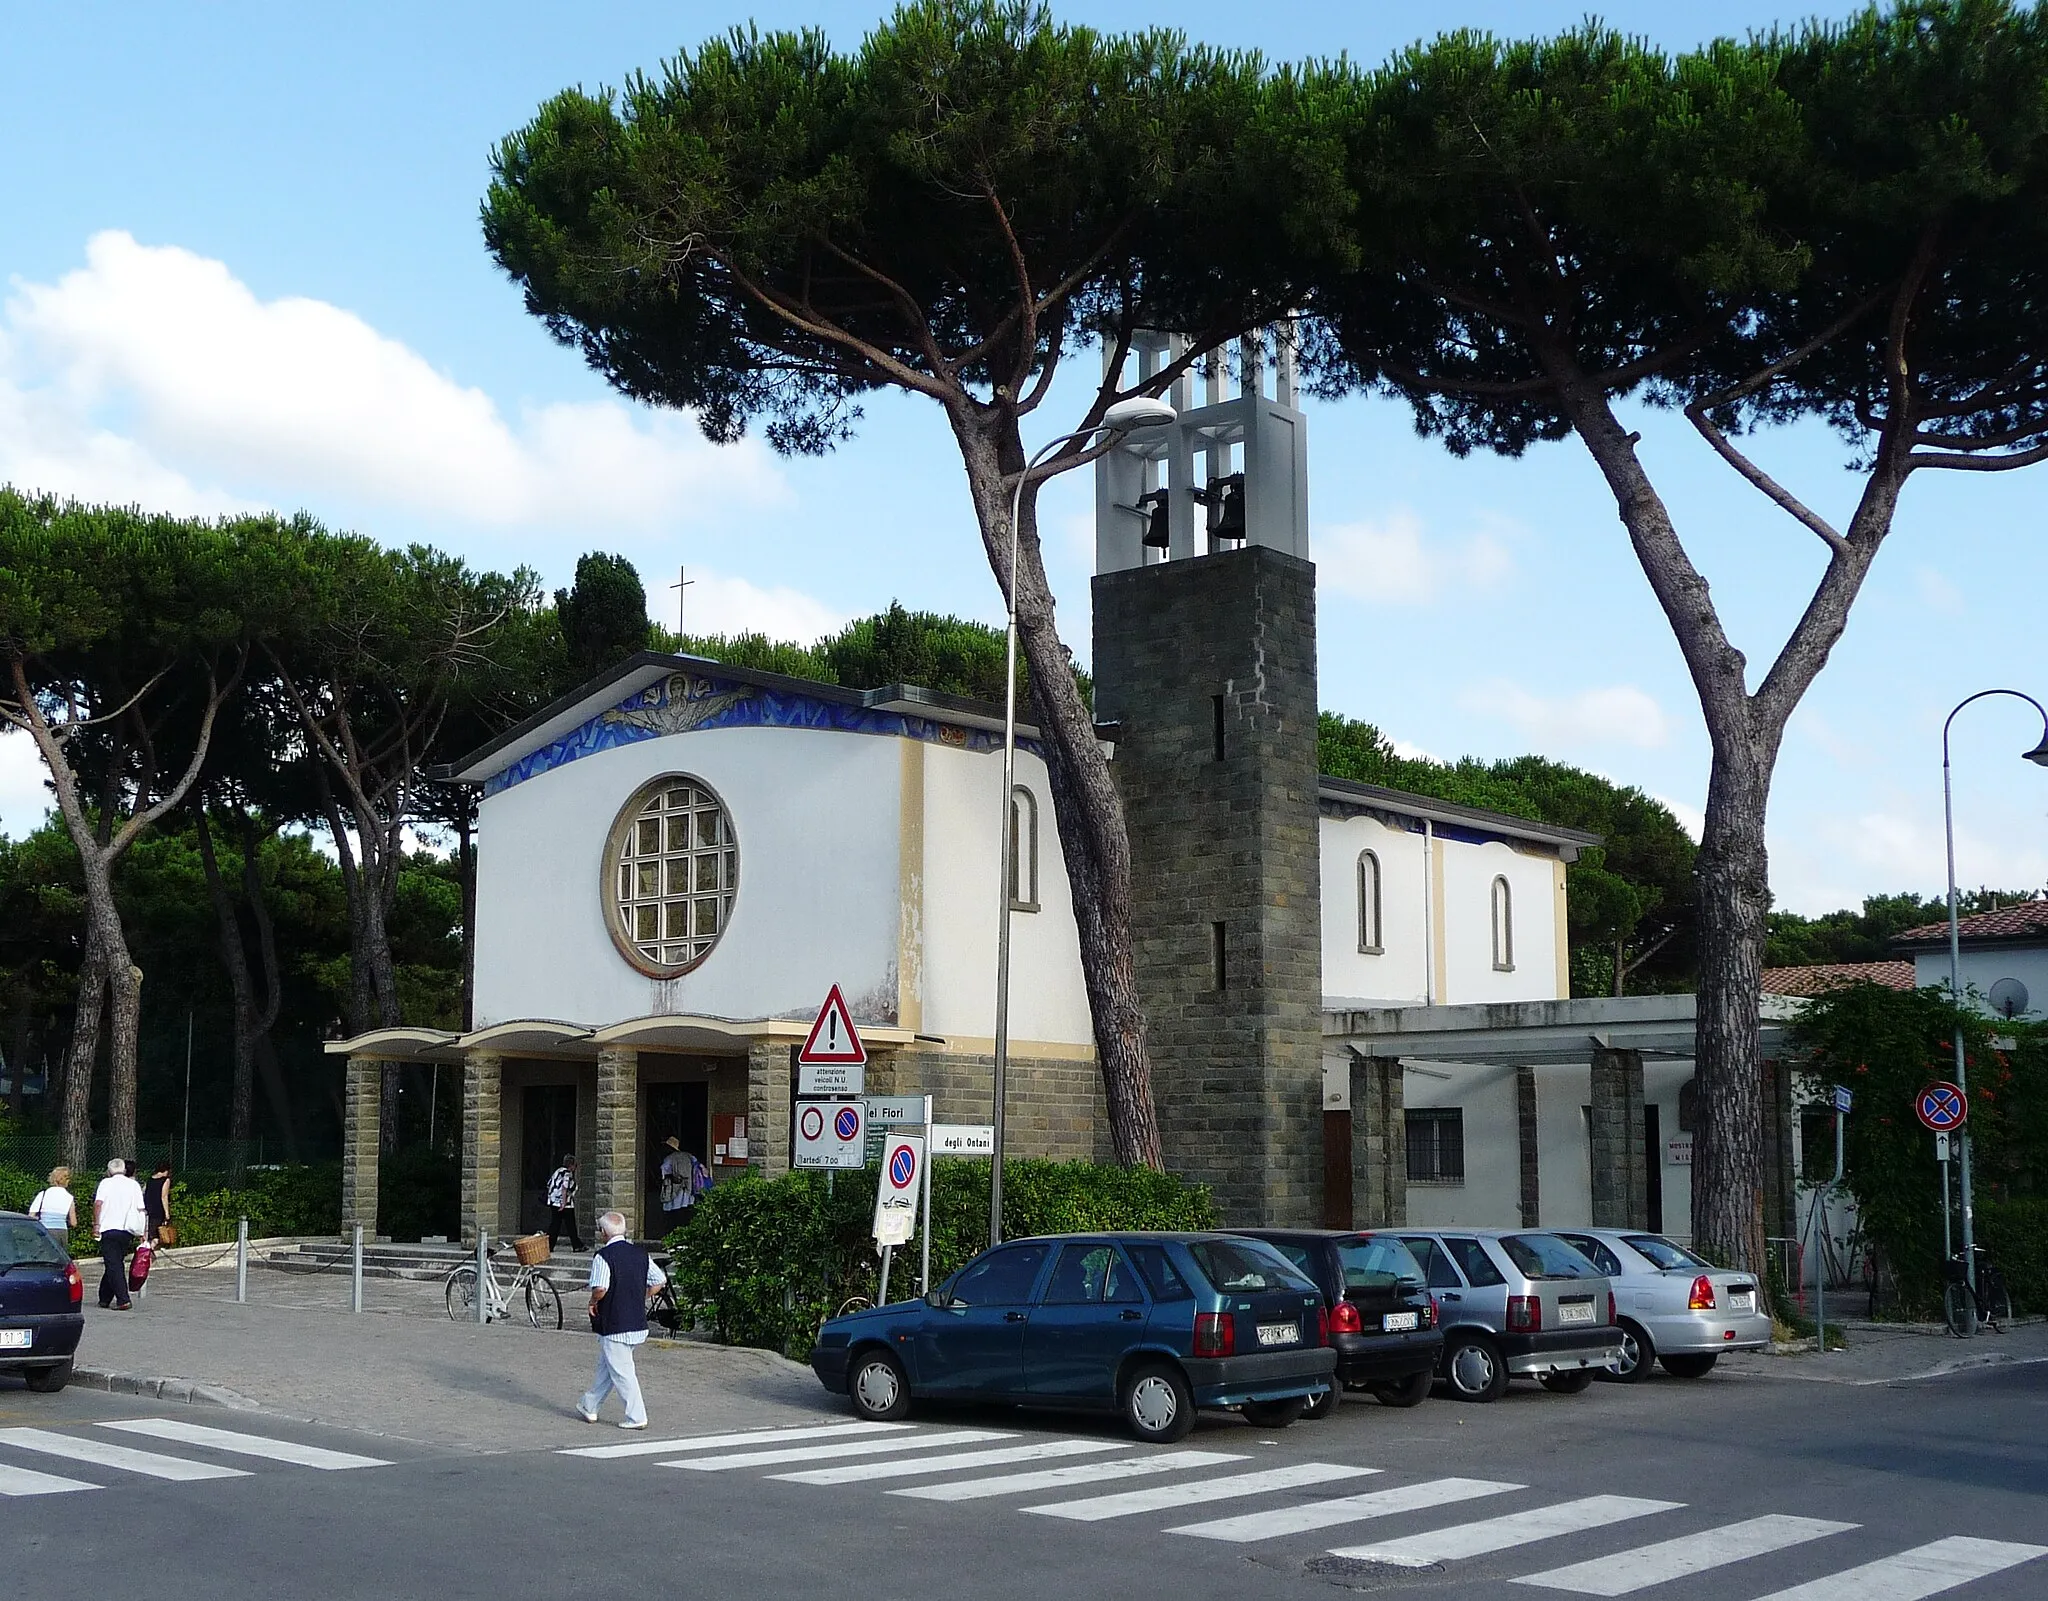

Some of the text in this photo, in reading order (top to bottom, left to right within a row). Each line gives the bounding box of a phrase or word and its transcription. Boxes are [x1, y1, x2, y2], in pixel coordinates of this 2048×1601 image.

[816, 1067, 846, 1075] attenzione
[882, 1107, 903, 1118] Fiori
[944, 1137, 990, 1149] degli Ontani
